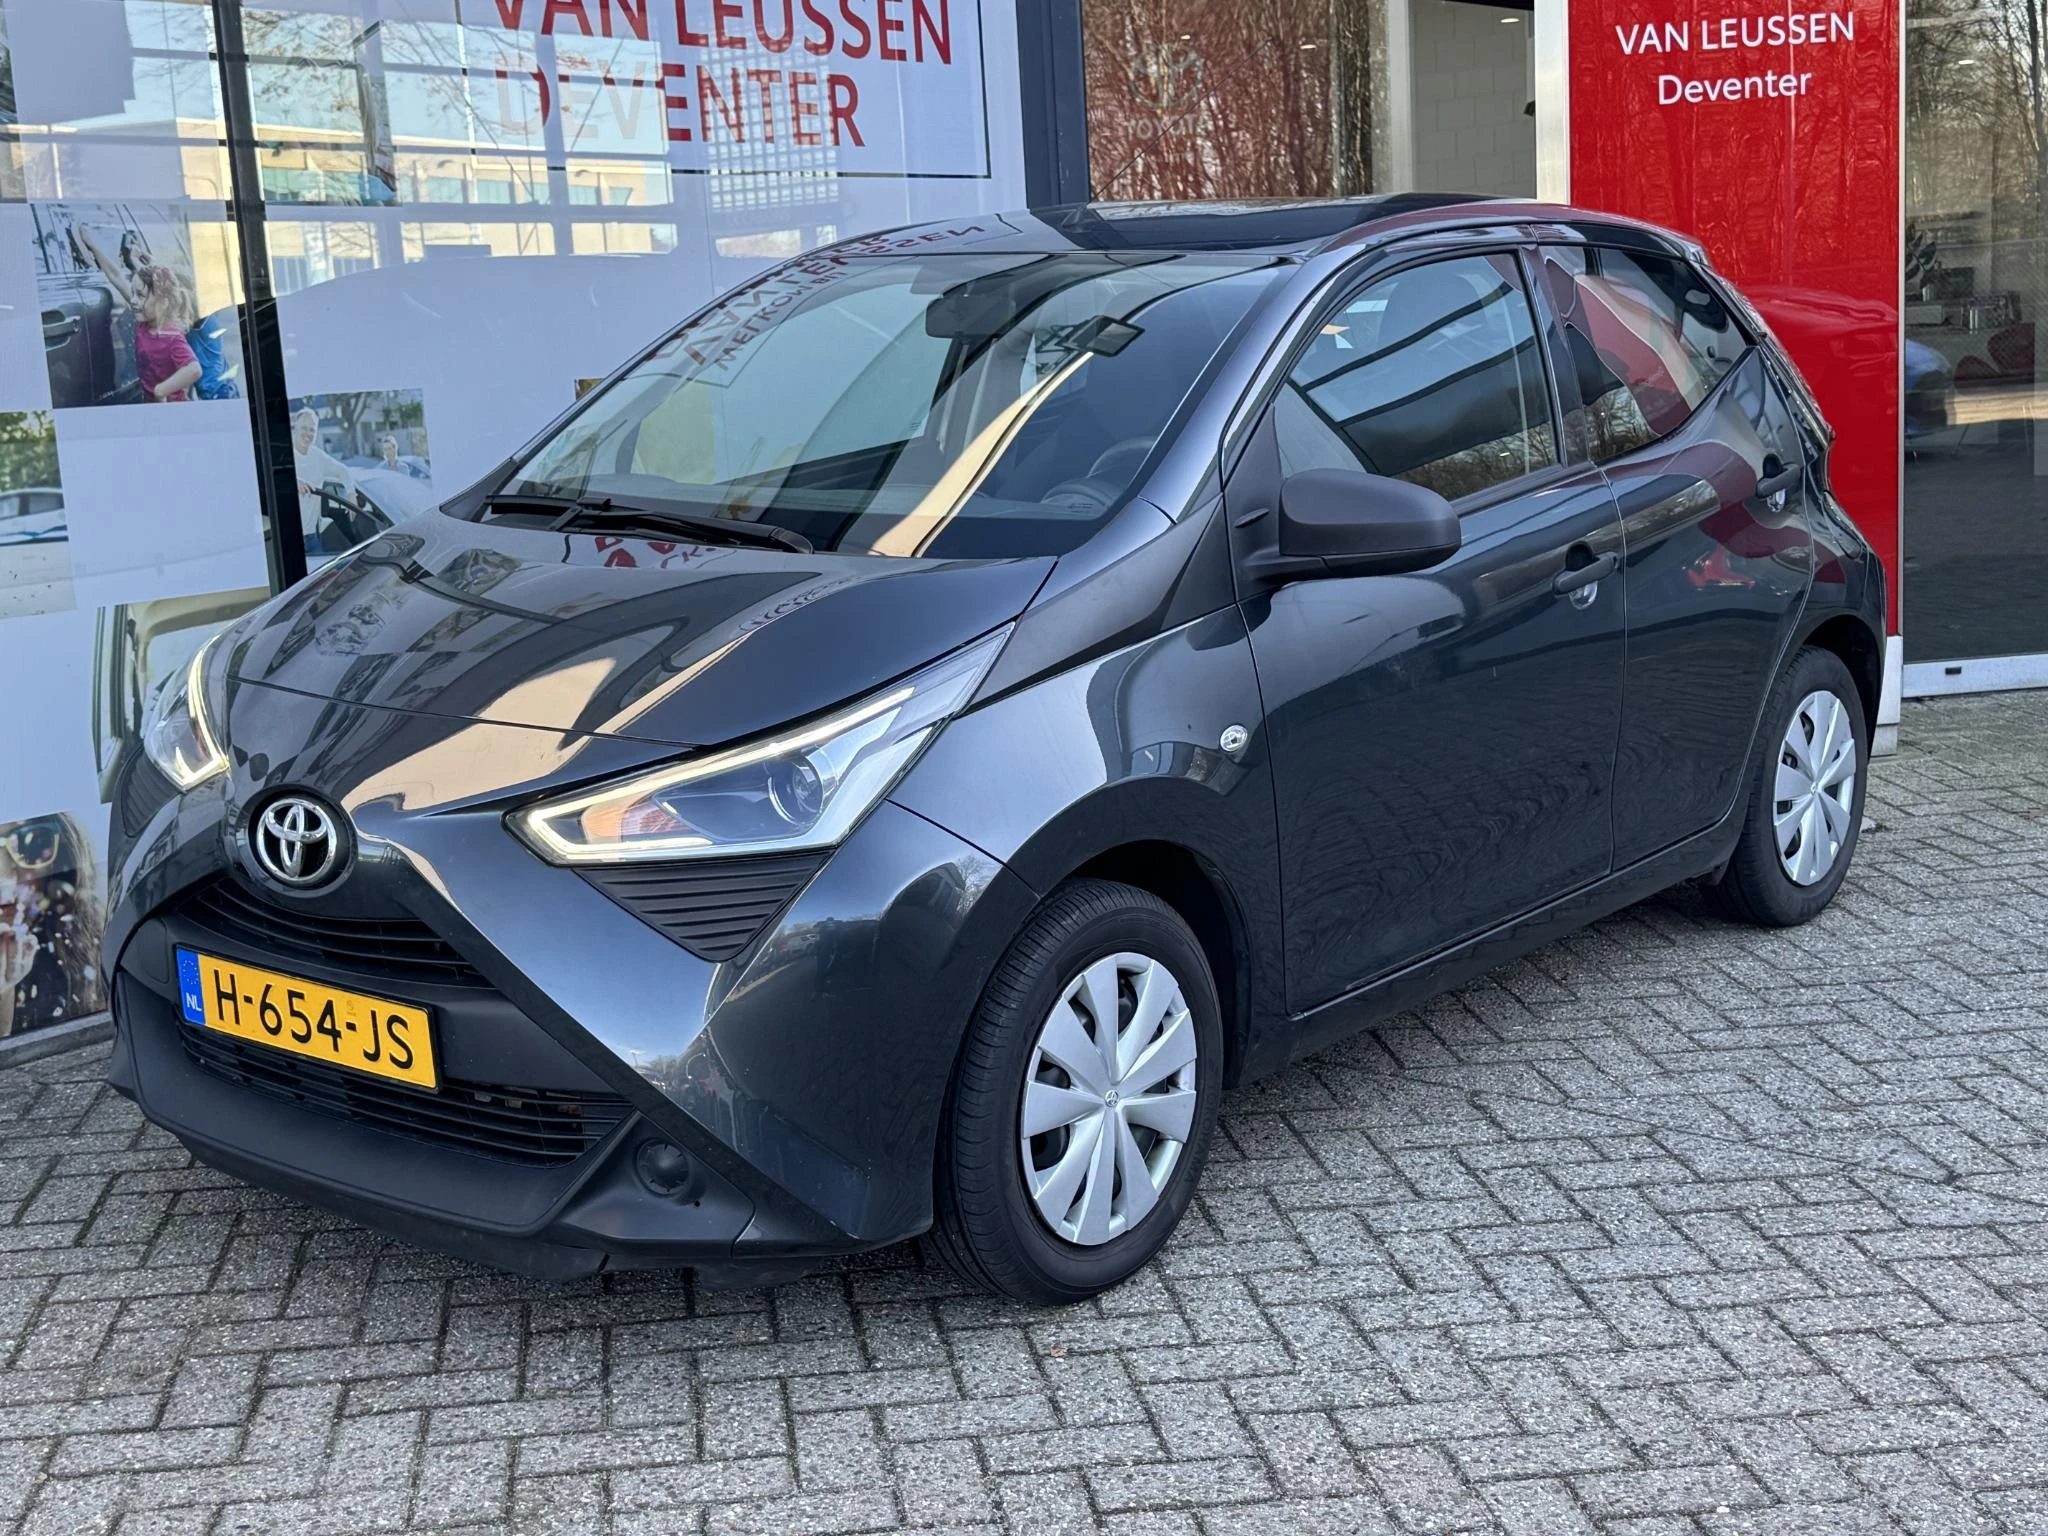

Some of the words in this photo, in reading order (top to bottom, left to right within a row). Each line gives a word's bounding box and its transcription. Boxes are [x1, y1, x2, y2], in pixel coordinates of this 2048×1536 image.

[676, 0, 953, 65] LEUSSEN
[1615, 21, 1689, 56] VAN
[1701, 11, 1855, 50] LEUSSEN
[494, 54, 866, 147] DEVENTER
[1657, 70, 1812, 105] Deventer
[185, 992, 202, 1012] NL
[213, 968, 414, 1070] H-654-JS
